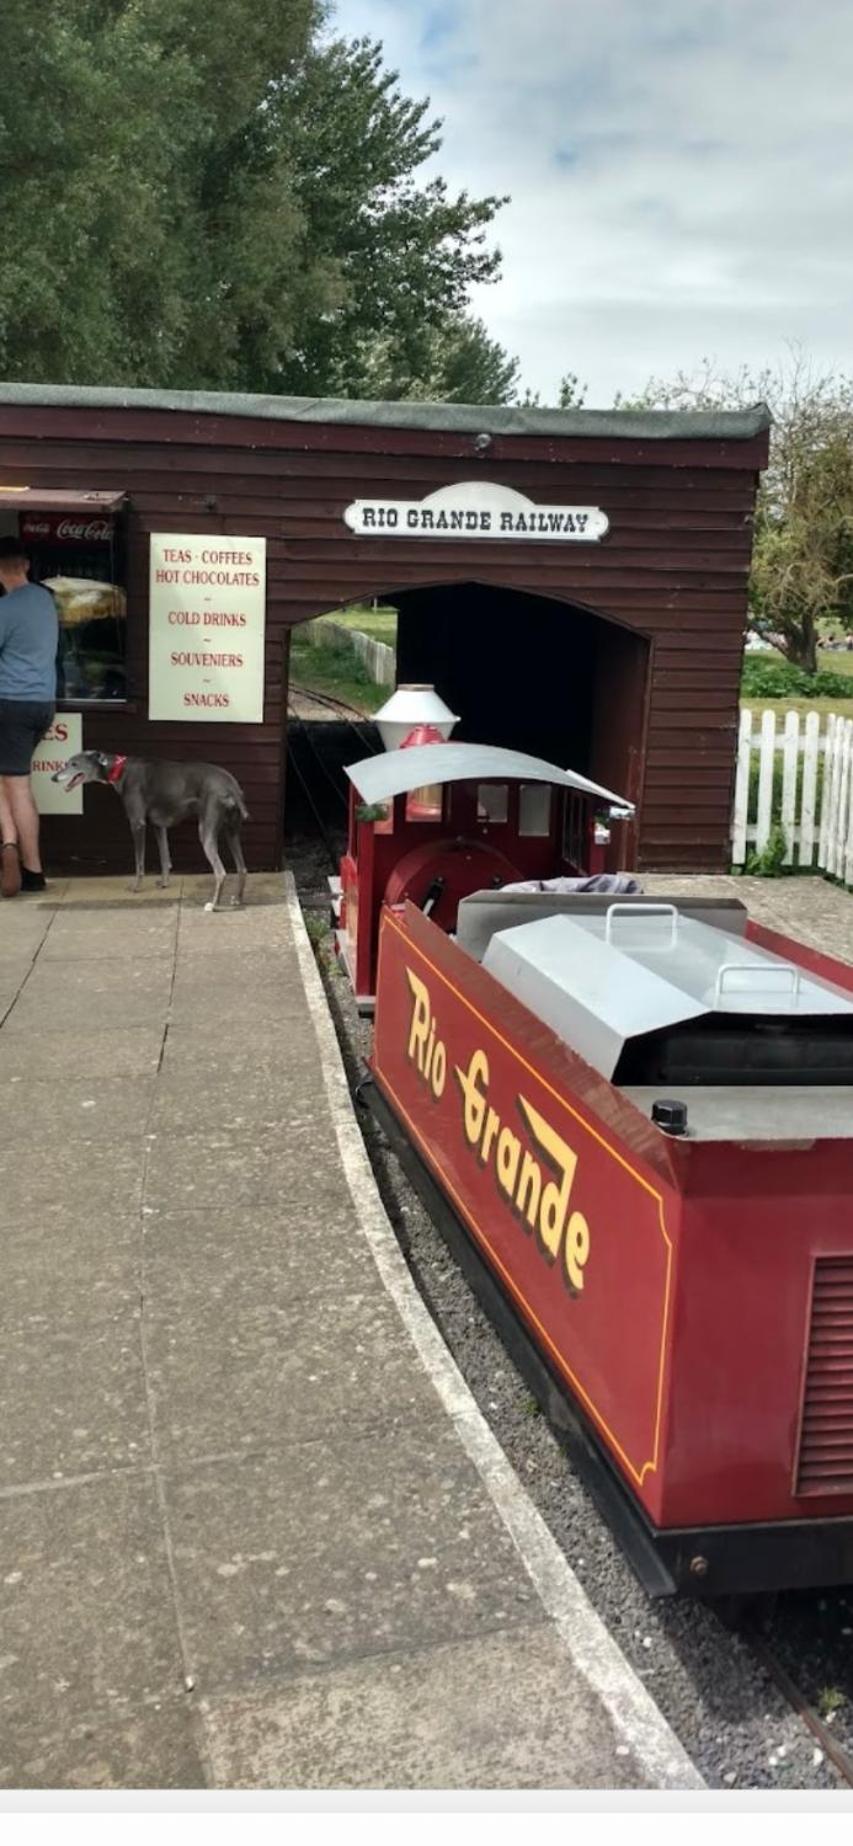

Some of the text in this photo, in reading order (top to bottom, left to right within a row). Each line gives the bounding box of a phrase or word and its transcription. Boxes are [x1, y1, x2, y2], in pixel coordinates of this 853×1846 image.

[362, 508, 588, 533] RIO GRANDE RAILWAY
[164, 549, 253, 565] TEAS COFFEES
[156, 570, 260, 586] HOT CHOCOLATES
[168, 611, 247, 627] COLD DRINKS
[170, 652, 243, 667] SOUVENIERS
[183, 693, 229, 708] SNACKS
[406, 966, 590, 1290] Rio Grande
